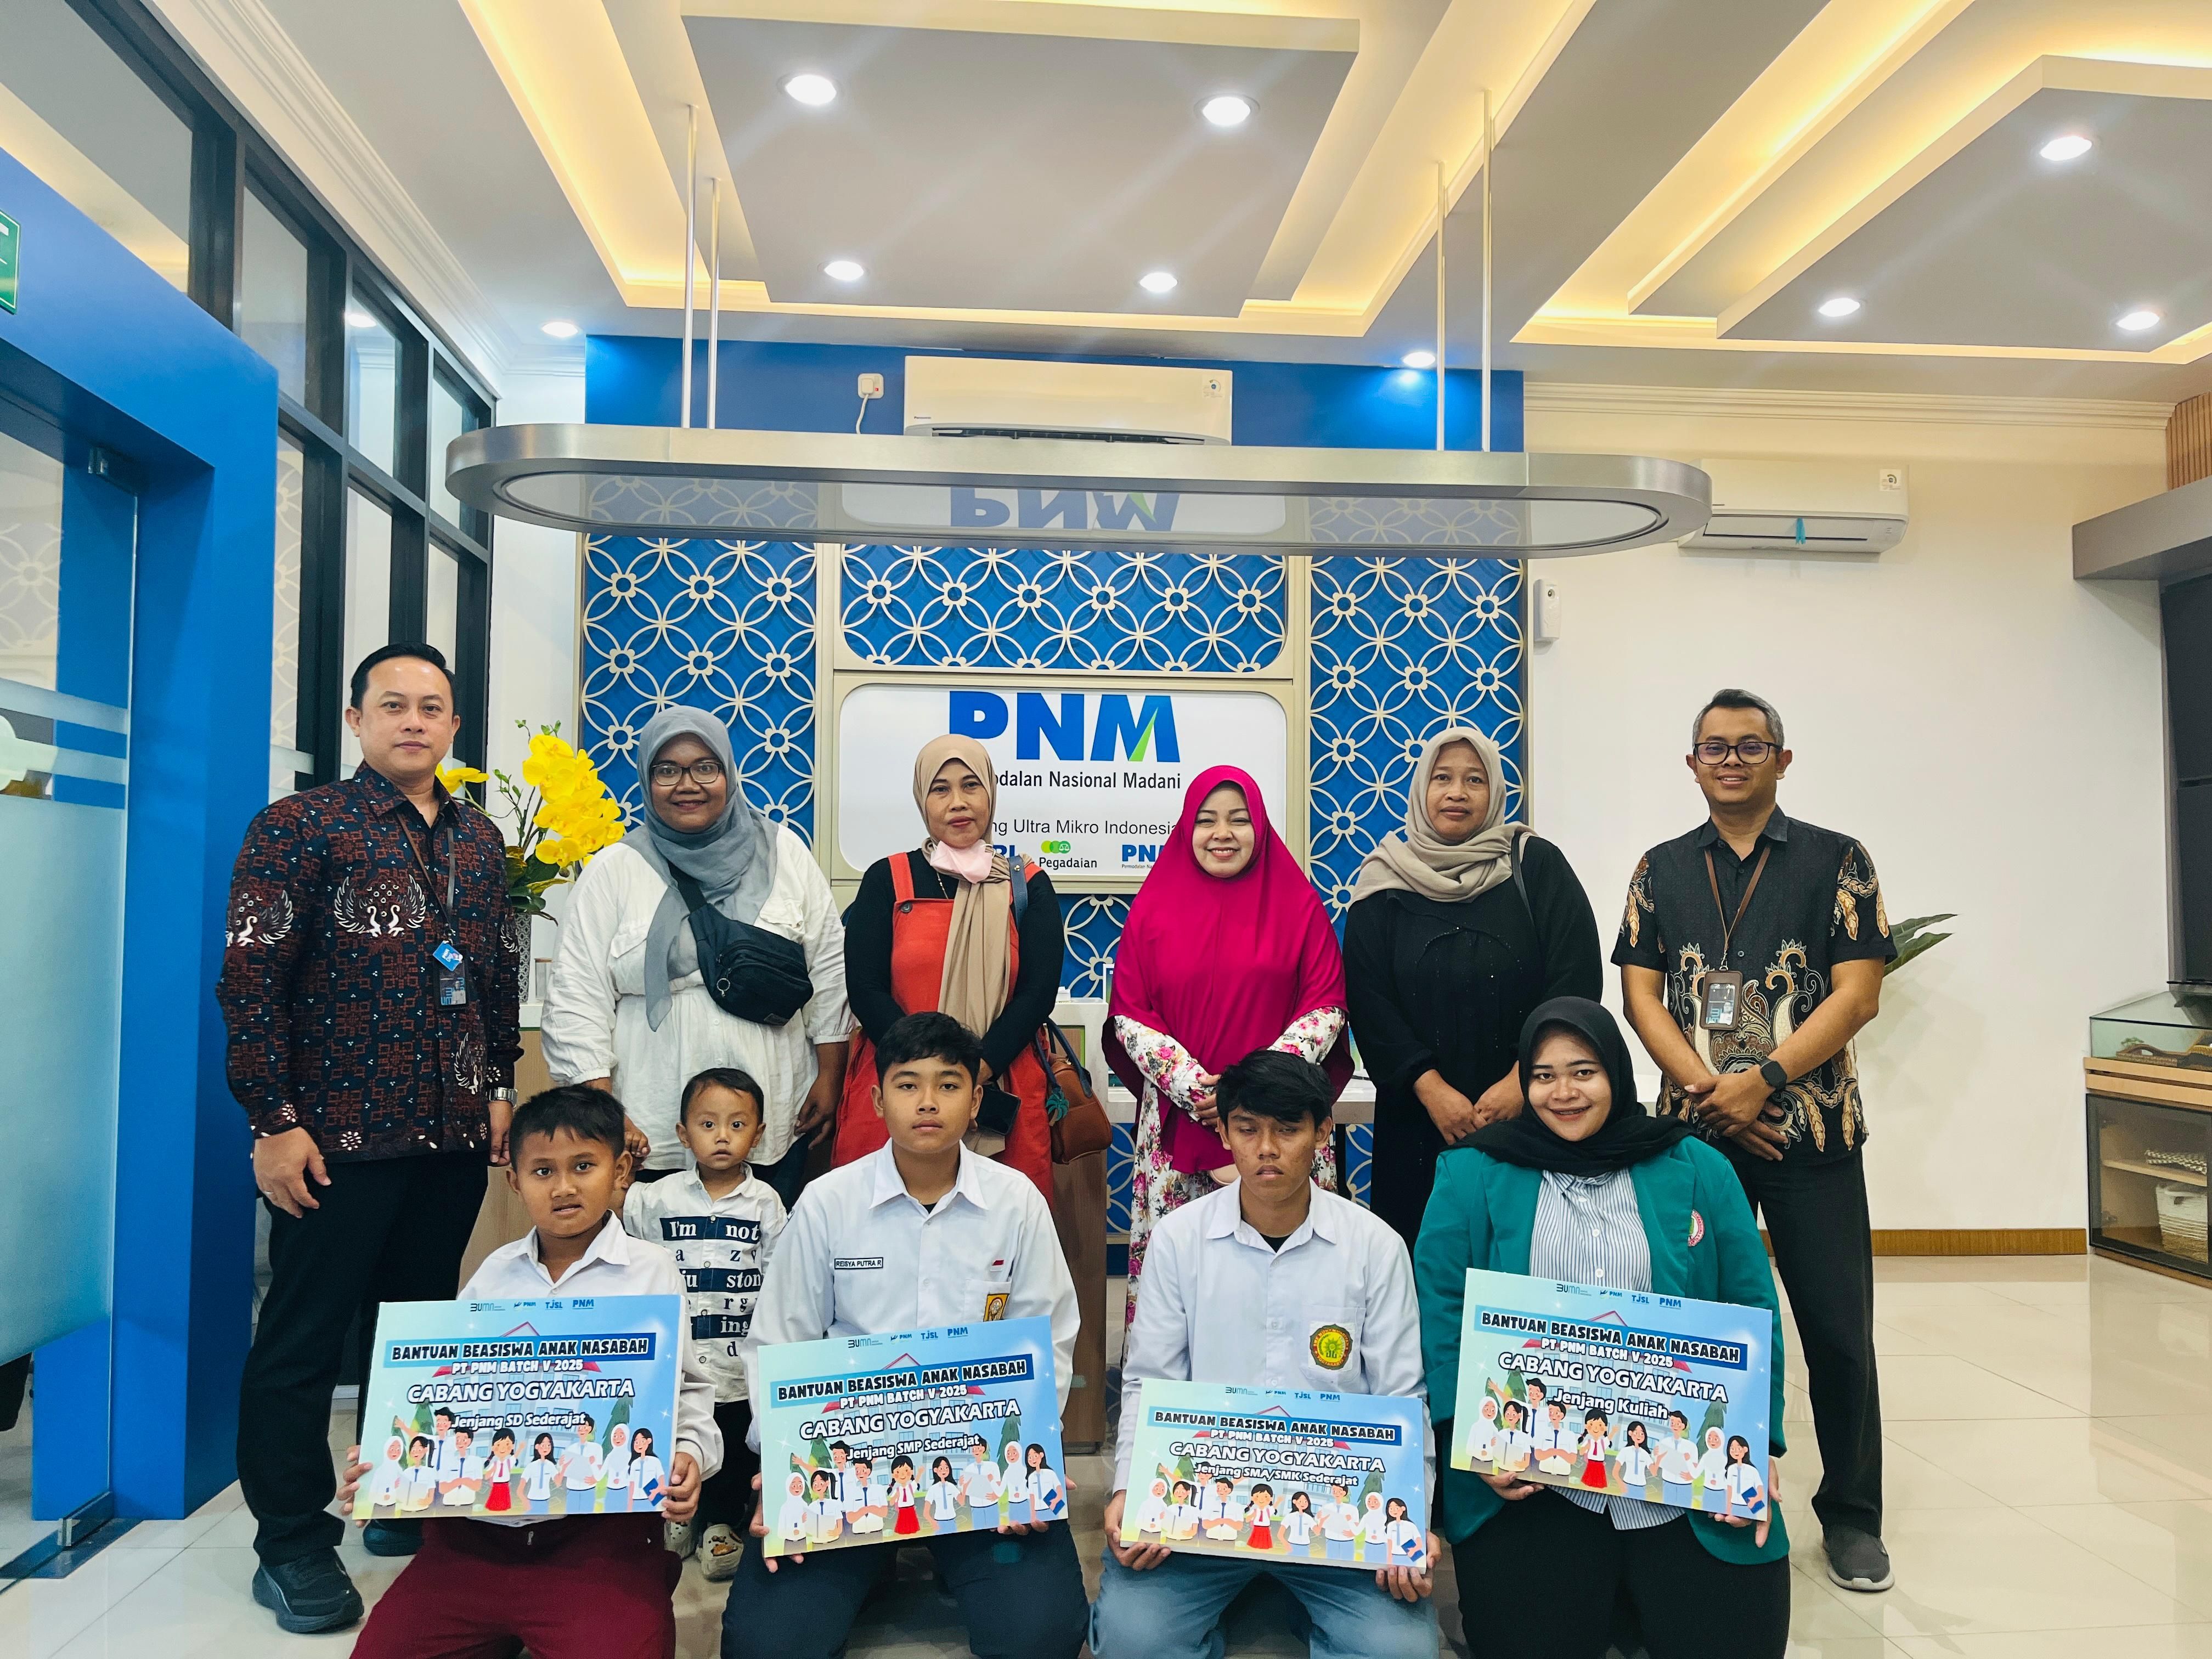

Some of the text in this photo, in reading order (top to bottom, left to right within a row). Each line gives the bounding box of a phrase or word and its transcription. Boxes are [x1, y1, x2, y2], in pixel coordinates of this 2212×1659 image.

[950, 691, 1180, 762] PNM
[995, 770, 1180, 789] dalan Nasional Madani
[1014, 819, 1050, 833] Ultra
[1057, 820, 1098, 833] Mikro
[1105, 820, 1176, 834] Indonesi
[1039, 857, 1097, 870] Pegadaian
[1122, 844, 1165, 862] PN
[670, 1221, 760, 1241] I'm not
[545, 1300, 562, 1308] TJSL
[1632, 1294, 1649, 1304] TJSL
[1660, 1297, 1681, 1307] PNM
[921, 1330, 938, 1339] TJSL
[947, 1327, 968, 1336] PNM
[1481, 1312, 1740, 1362] BANTUAN BEASISWA ANAK NASABAH
[392, 1338, 648, 1361] BANTUAN BEASISWA ANAK NASABAH
[1541, 1338, 1673, 1367] PT PNM BATCH V 2025
[452, 1359, 583, 1374] PT PNM BATCH V 2025
[1499, 1352, 1728, 1402] CABANG YOGYAKARTA
[408, 1379, 635, 1403] CABANG YOGYAKARTA
[778, 1360, 1026, 1401] BANTUAN BEASISWA ANAK NASABAH
[840, 1385, 967, 1409] PT PNM BATCH V 2025
[1552, 1389, 1668, 1420] Jenjang Kuliah
[452, 1412, 585, 1430] Jenjang SD Sederajat
[800, 1399, 1021, 1440] CABANG YOGYAKARTA
[1154, 1411, 1395, 1440] BANTUAN BEASISWA ANAK NASABAH
[846, 1435, 979, 1462] Jenjang SMP Sederajat
[1210, 1429, 1334, 1447] PT PNM BATCH V 2025
[1170, 1442, 1385, 1471] CABANG YOGYAKARTA
[1195, 1464, 1357, 1487] Jenjang SMA/SMK Sederajat
